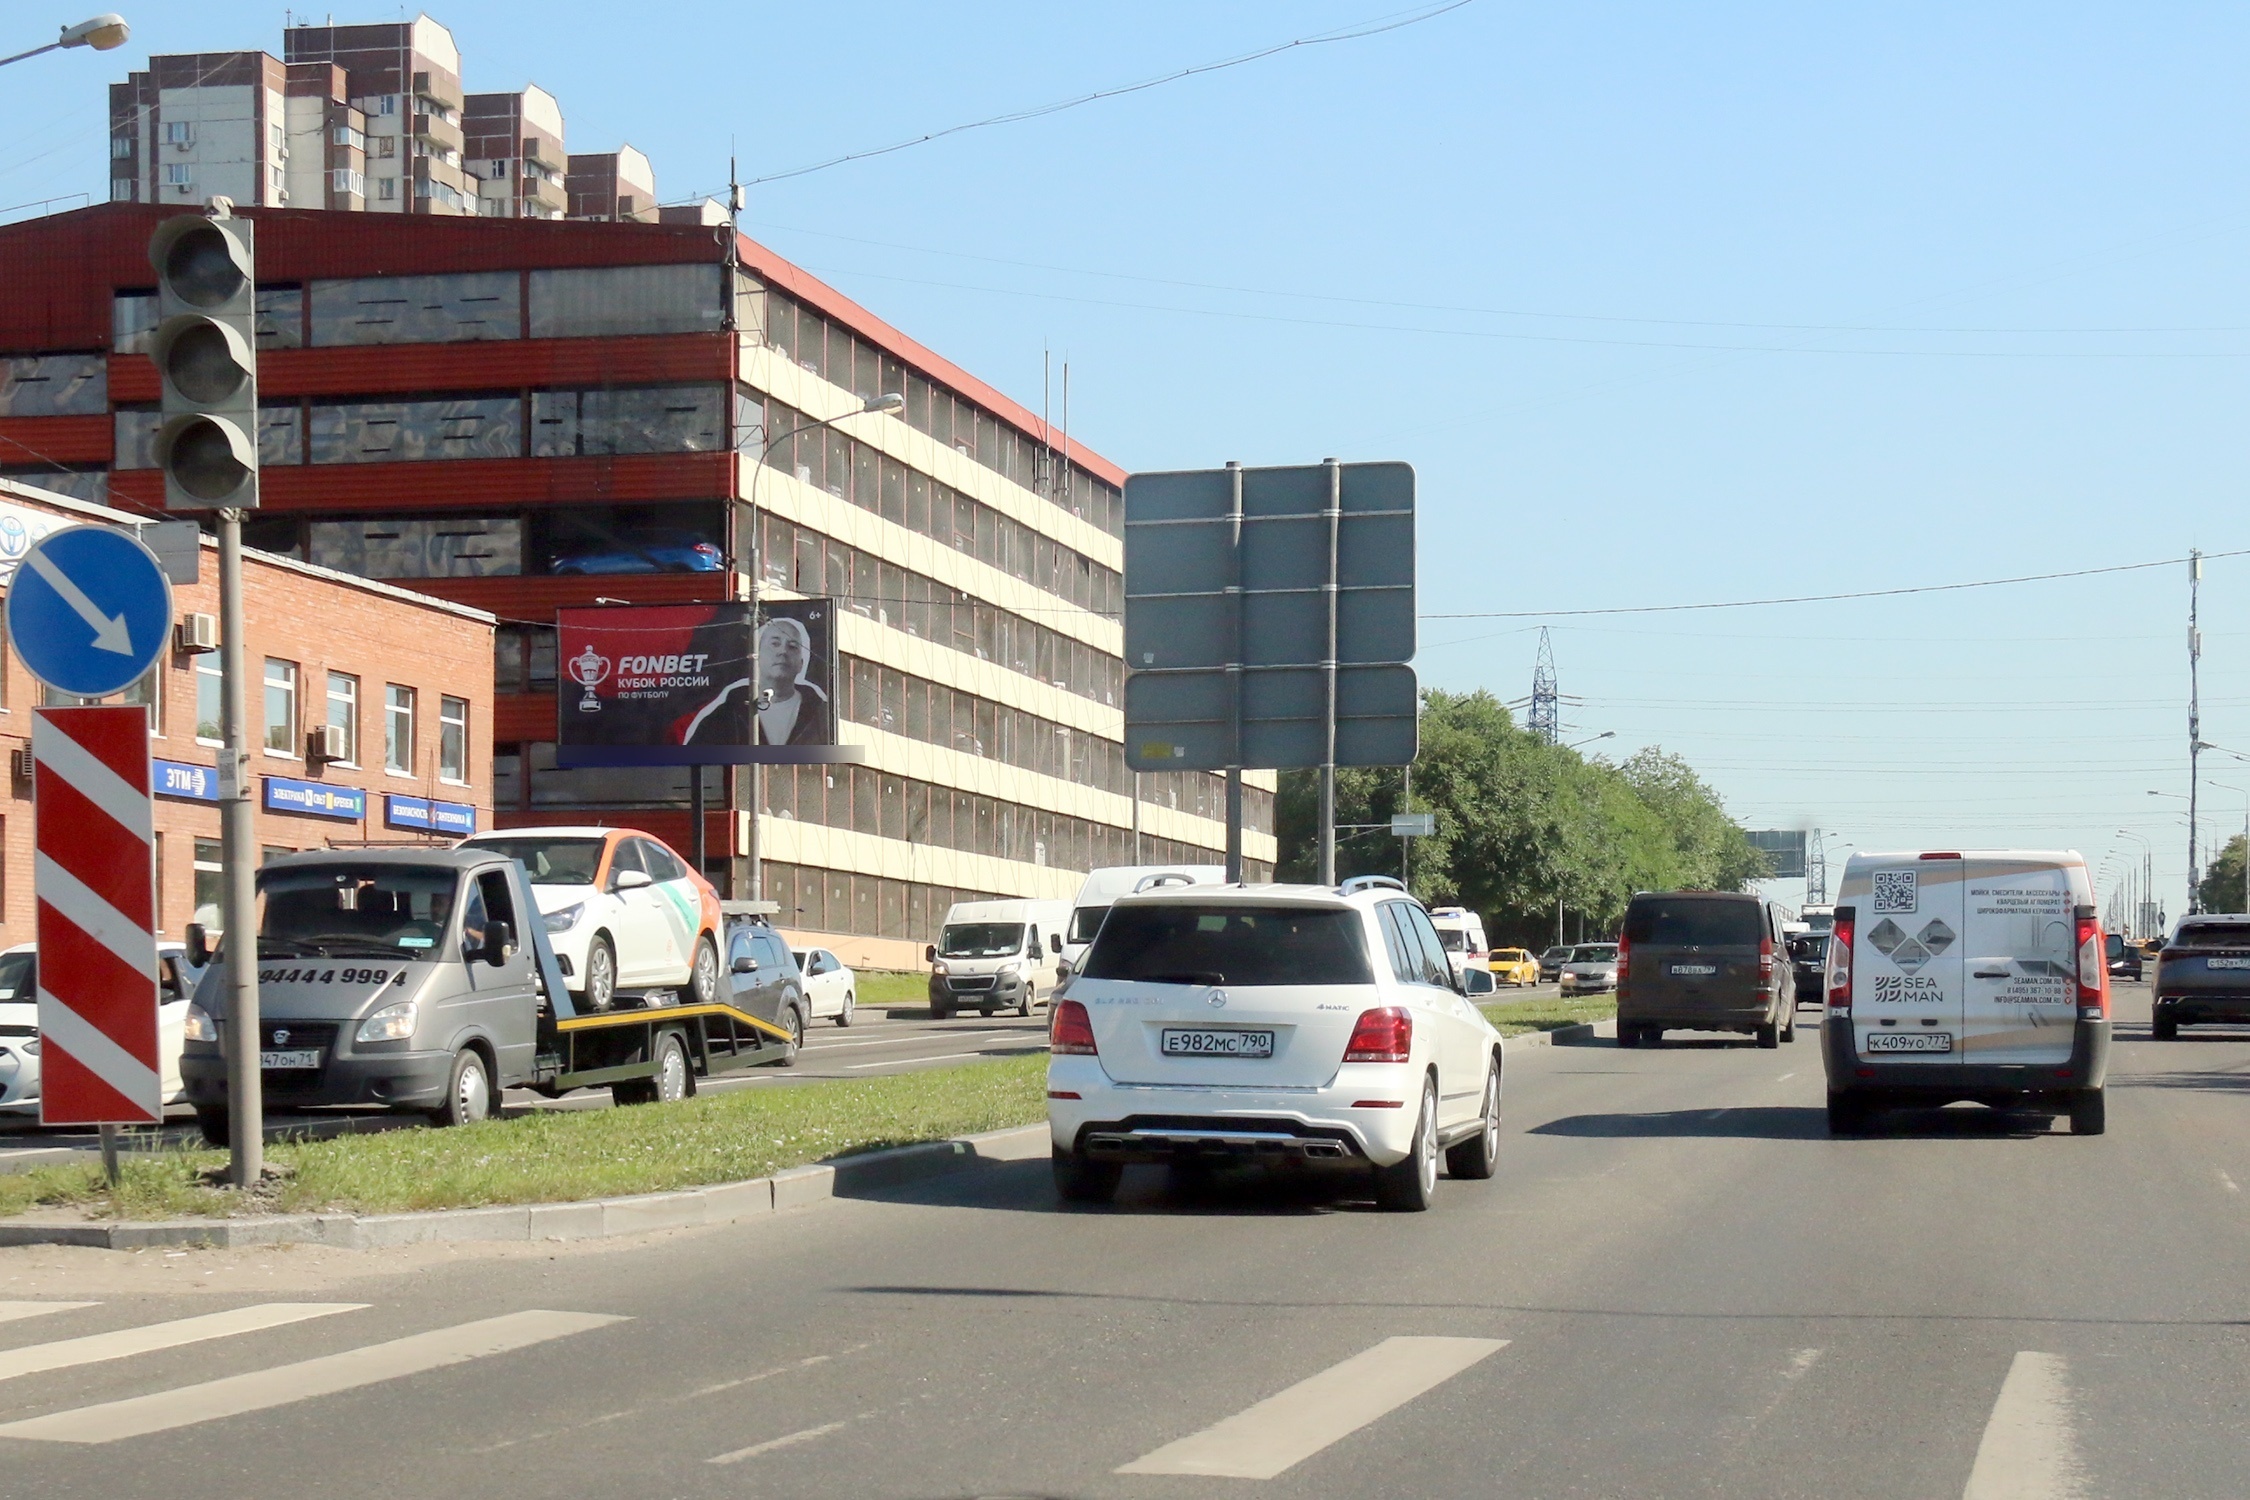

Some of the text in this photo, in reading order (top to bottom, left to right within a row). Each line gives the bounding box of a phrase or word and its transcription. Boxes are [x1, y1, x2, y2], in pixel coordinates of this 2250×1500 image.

[809, 610, 821, 620] 6+
[617, 654, 708, 675] FONBET
[617, 675, 709, 689] КУБОК РОССИИ
[617, 690, 669, 699] ПО ФУТБОЛУ
[166, 767, 192, 791] ЭТМ
[273, 787, 305, 803] ЭЛЕКТРИКА
[313, 793, 326, 805] СВЕТ
[1904, 977, 1937, 989] SEA
[1904, 991, 1943, 1002] MAN
